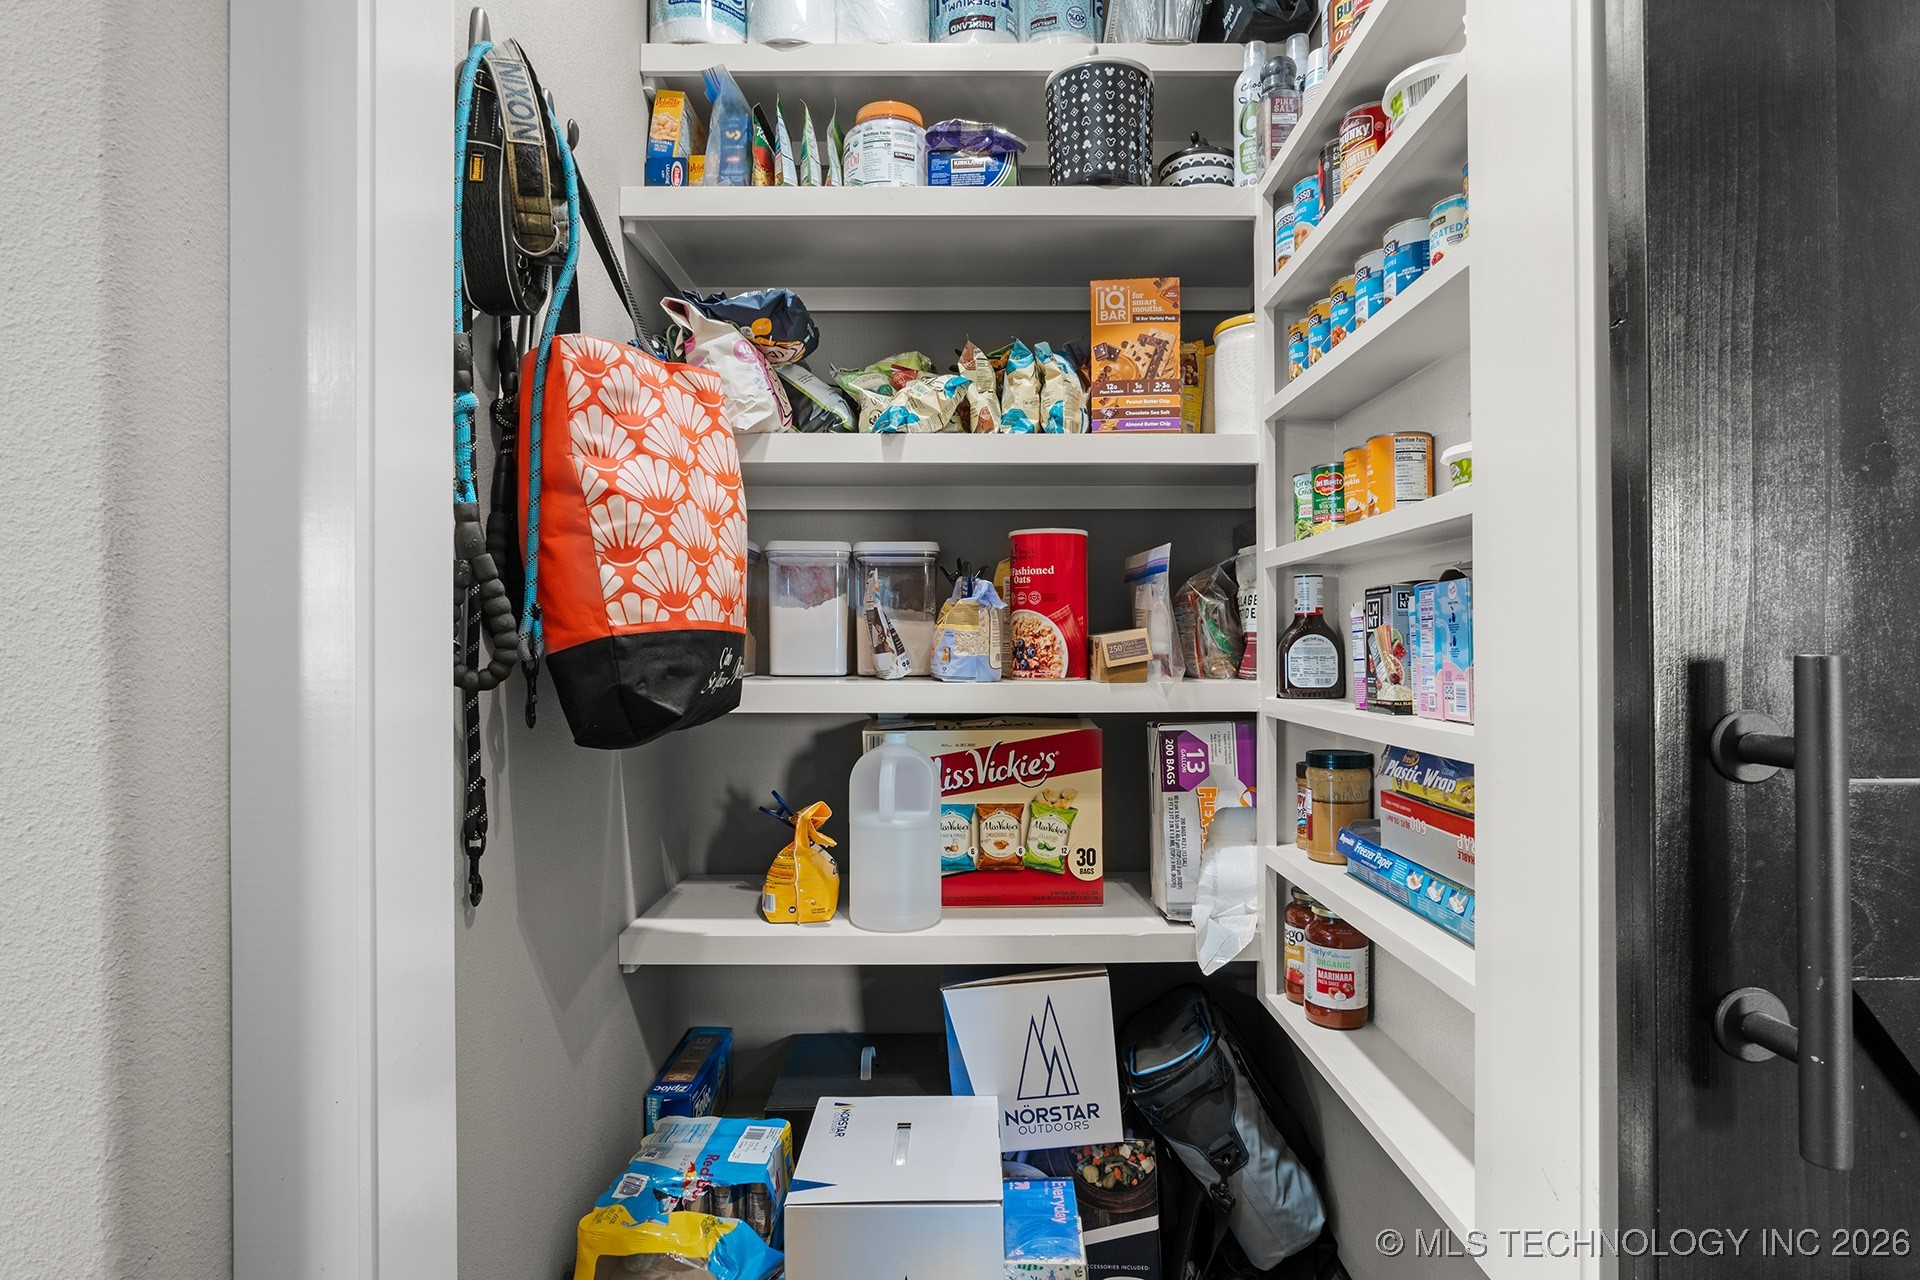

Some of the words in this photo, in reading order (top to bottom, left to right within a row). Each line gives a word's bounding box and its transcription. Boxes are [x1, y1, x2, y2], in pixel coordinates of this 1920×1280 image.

[950, 19, 994, 34] KIRKLAND
[498, 62, 540, 142] NIXON
[1274, 105, 1295, 113] SALT
[1100, 291, 1125, 310] IQ
[1132, 305, 1165, 313] mouths.
[1100, 310, 1127, 321] BAR
[1012, 565, 1055, 576] Fashioned
[1013, 576, 1031, 584] Oats
[1108, 644, 1123, 654] 250
[1165, 739, 1175, 758] 200
[965, 740, 1057, 788] Vickie's
[1187, 748, 1206, 774] 13
[1166, 758, 1176, 785] BAGS
[1384, 759, 1423, 783] Plastic
[1422, 768, 1457, 794] Wrap
[1410, 816, 1427, 835] 600
[1076, 848, 1097, 867] 30
[1354, 841, 1377, 860] Freezer
[1374, 851, 1393, 869] Paper
[1316, 958, 1351, 969] ORGANIC
[1317, 970, 1353, 982] MARINARA
[653, 1084, 688, 1093] Ziploc
[1004, 1103, 1100, 1126] NÖRSTAR
[1018, 1120, 1090, 1135] OUTDOORS
[700, 1154, 720, 1178] Red
[1050, 1180, 1070, 1224] Everyday
